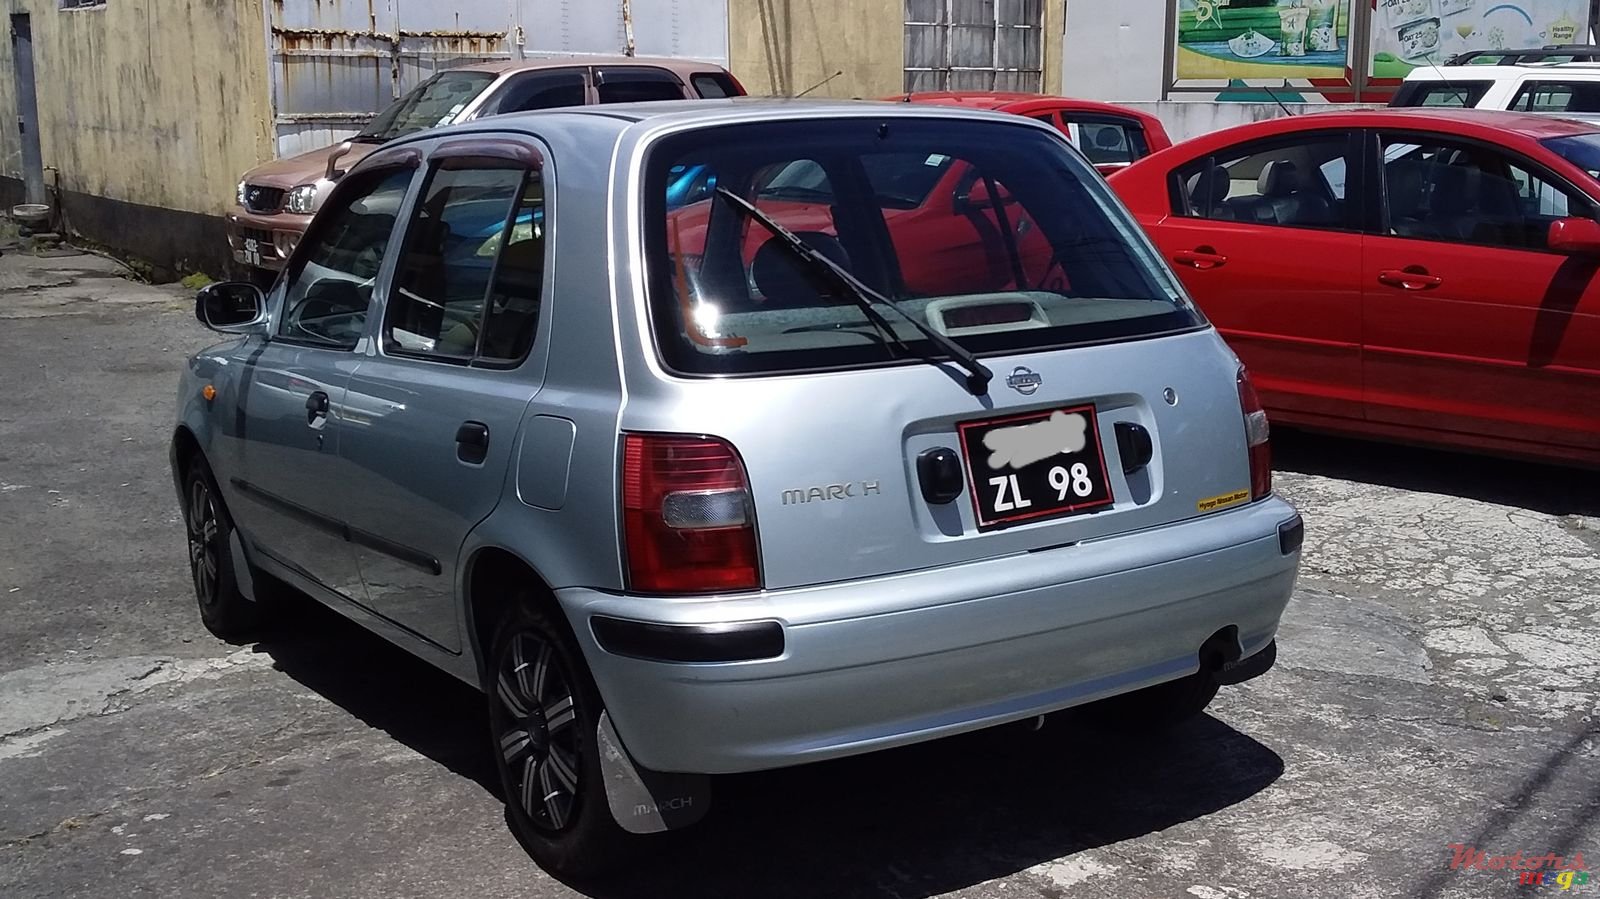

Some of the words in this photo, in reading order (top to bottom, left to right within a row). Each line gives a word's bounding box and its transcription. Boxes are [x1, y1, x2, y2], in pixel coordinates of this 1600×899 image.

[781, 480, 880, 506] MARCH
[988, 473, 1032, 513] ZL
[1048, 462, 1093, 501] 98
[1216, 495, 1234, 505] Nissan
[1233, 491, 1248, 500] Motor
